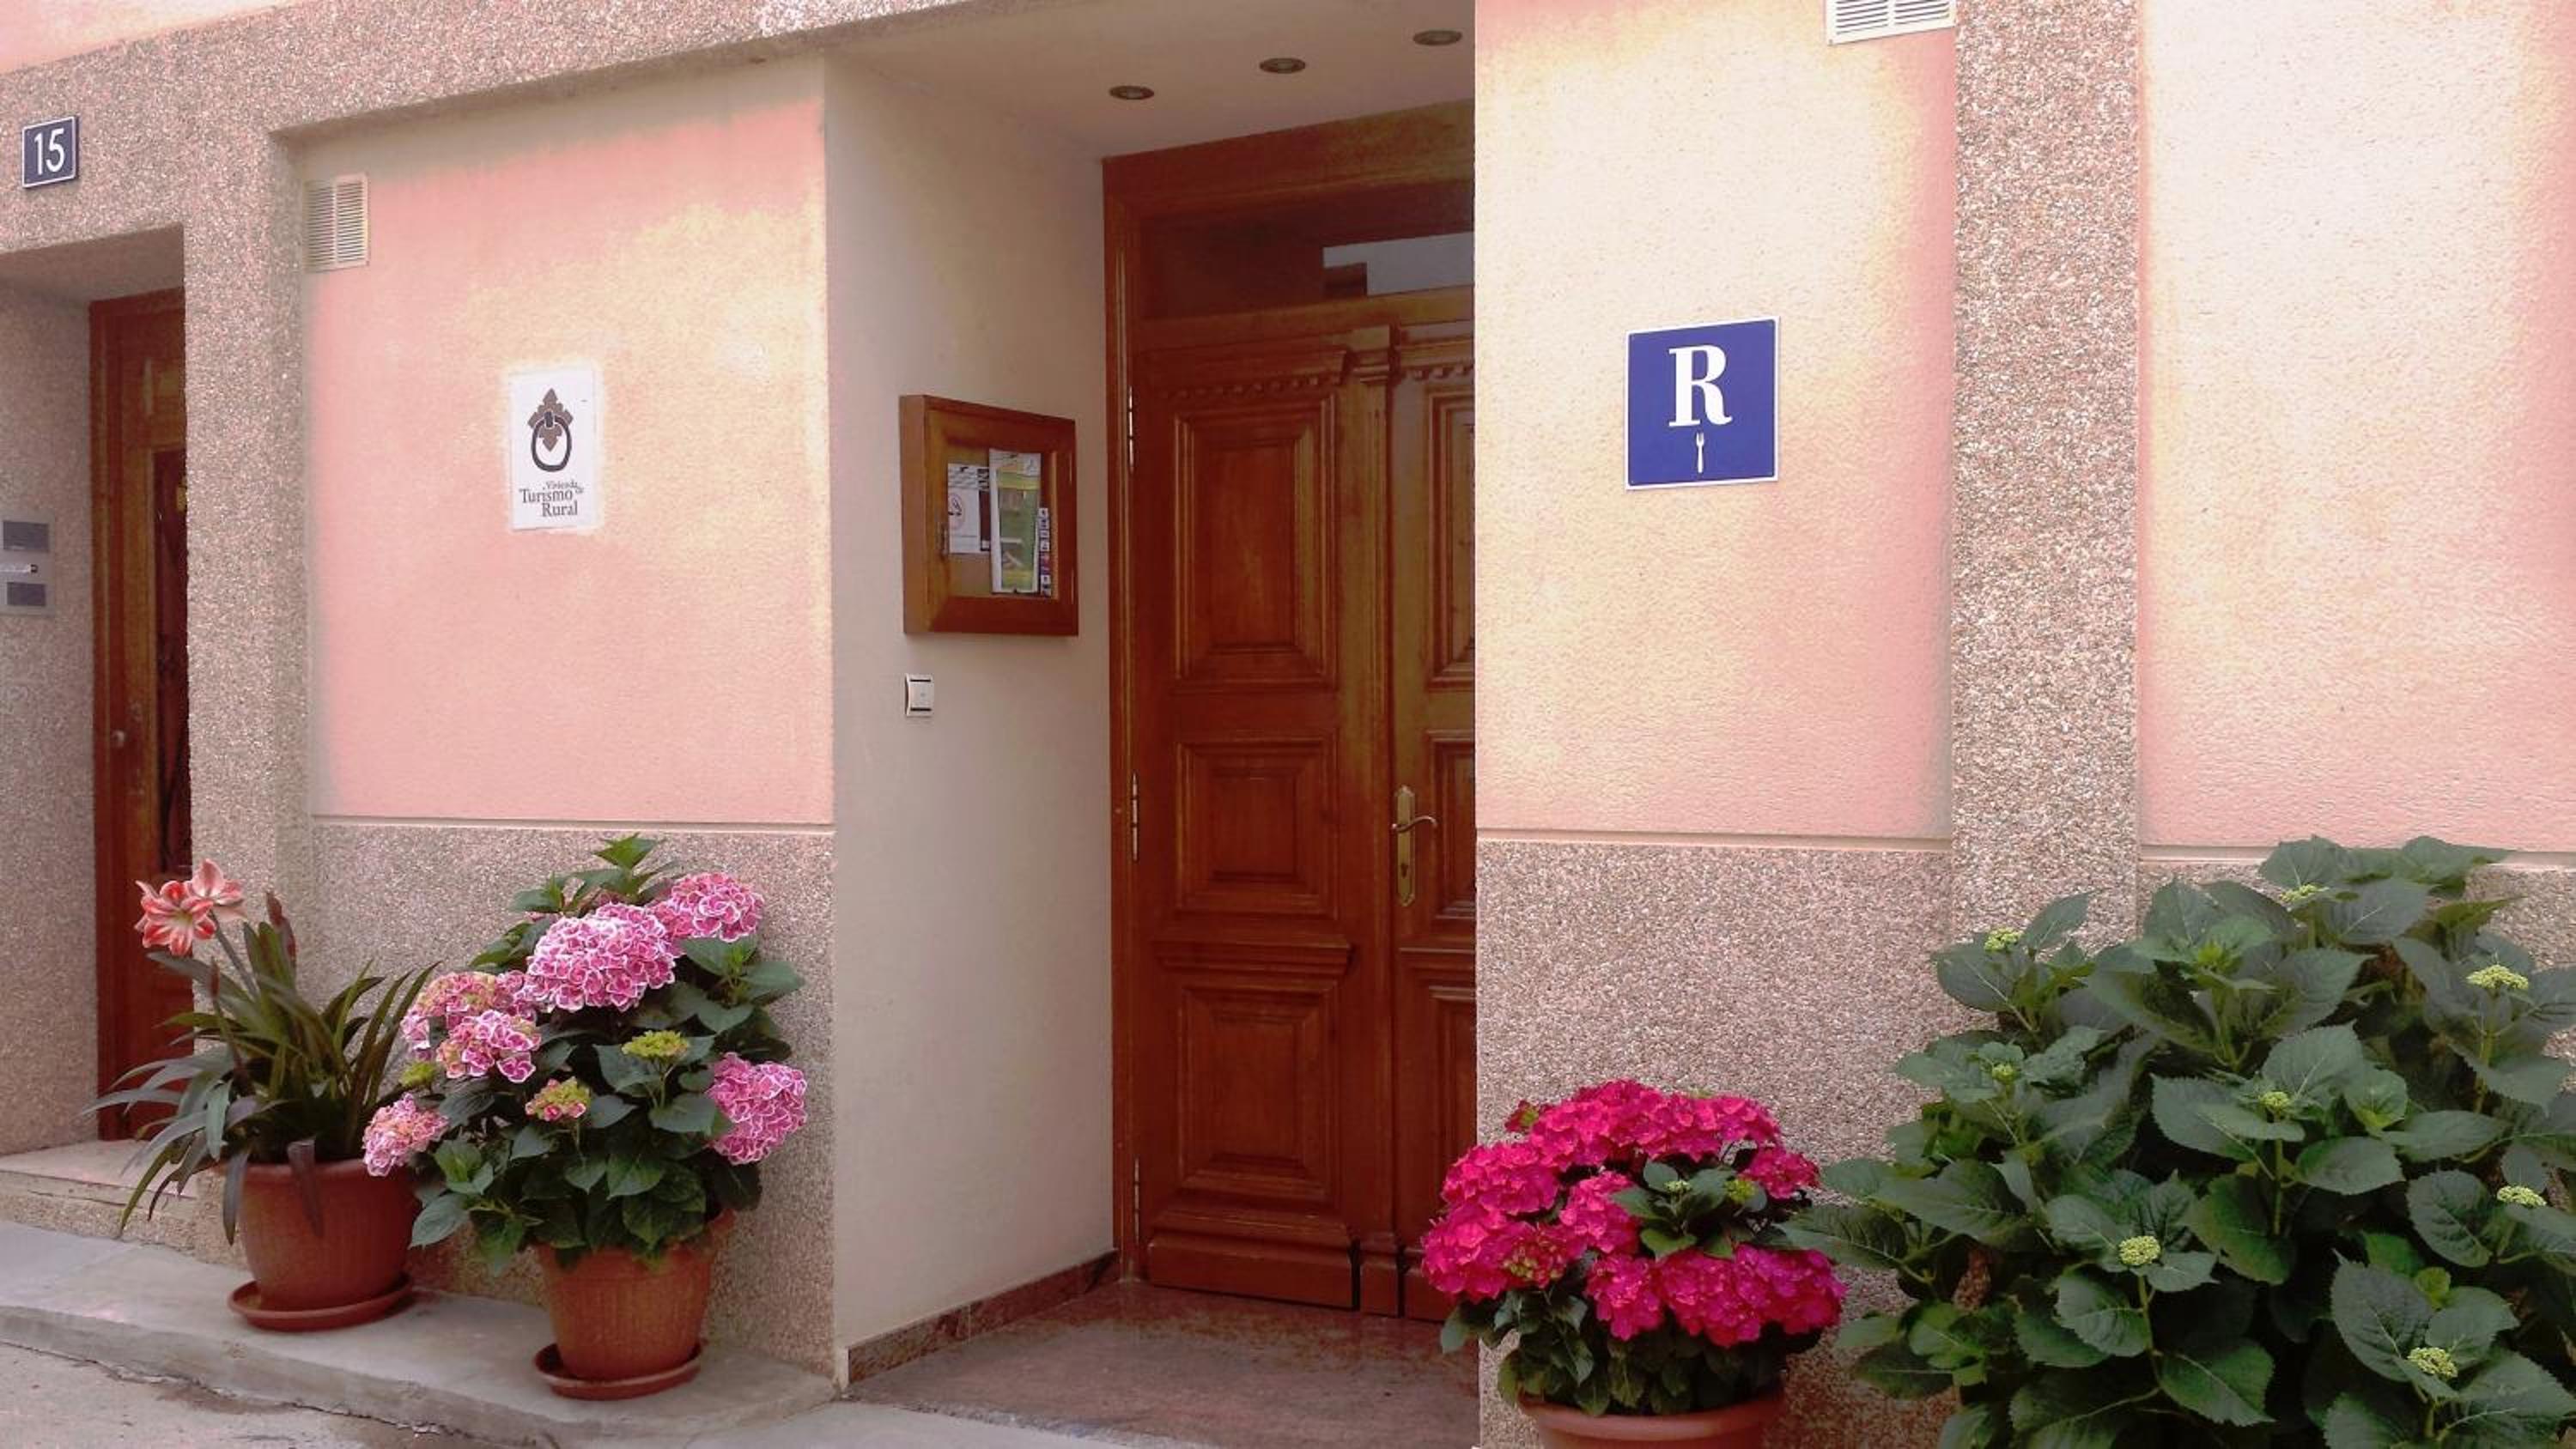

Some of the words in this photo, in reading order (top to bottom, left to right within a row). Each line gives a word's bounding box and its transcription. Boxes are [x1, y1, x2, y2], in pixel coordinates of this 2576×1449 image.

[34, 128, 65, 175] 15
[1668, 344, 1733, 427] R
[519, 488, 573, 503] Turismo
[542, 500, 578, 517] Rural
